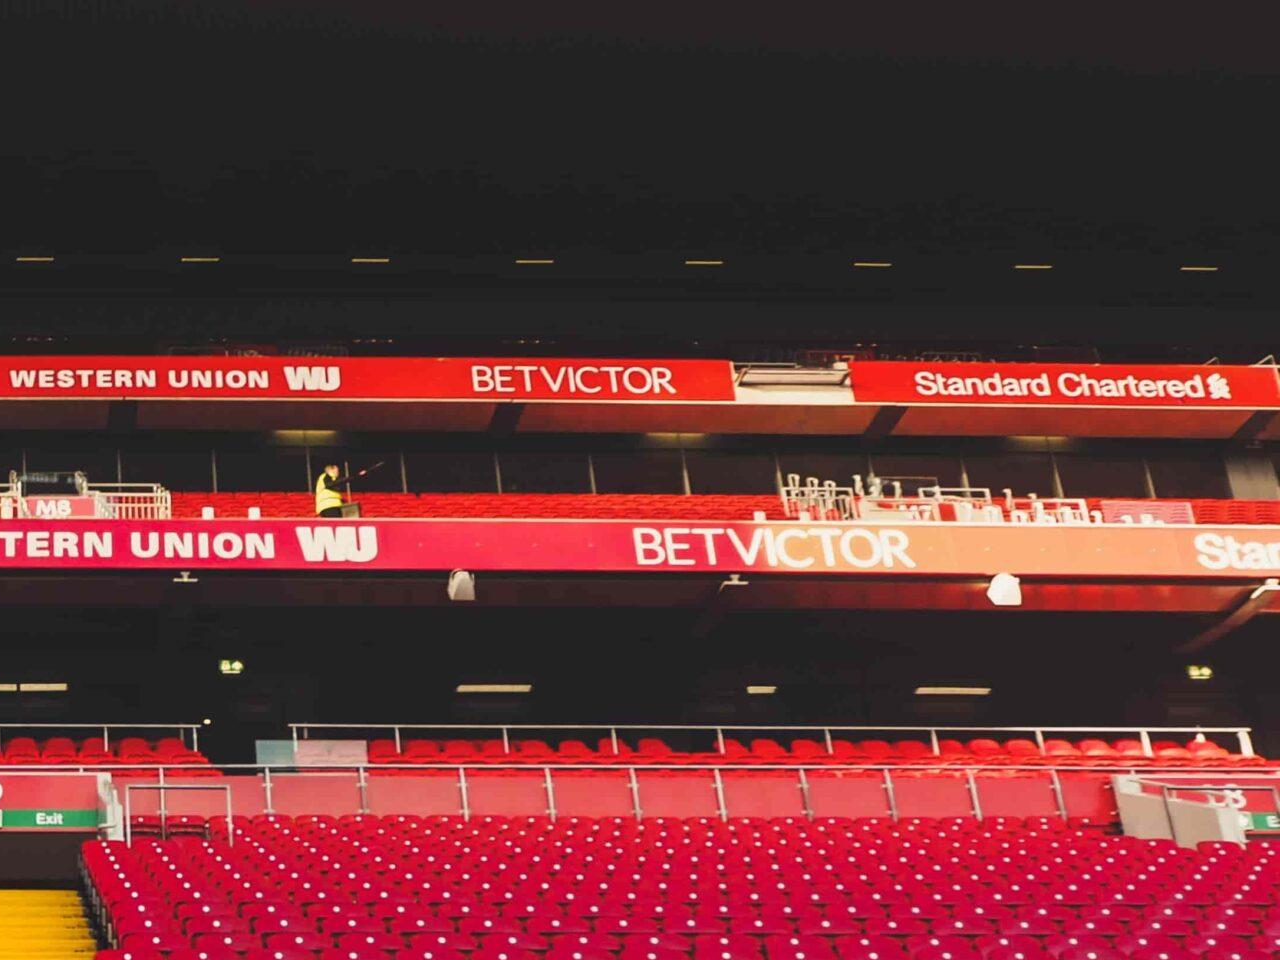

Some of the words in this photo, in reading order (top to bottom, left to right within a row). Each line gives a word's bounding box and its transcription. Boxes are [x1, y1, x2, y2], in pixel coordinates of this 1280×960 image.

[10, 369, 156, 388] WESTERN
[168, 370, 269, 389] UNION
[283, 366, 342, 391] WU
[470, 364, 677, 396] BETVICTOR
[914, 371, 1049, 397] Standard
[1058, 374, 1205, 399] Chartered
[130, 531, 275, 559] UNION
[295, 525, 379, 563] WU
[632, 527, 917, 570] BETVICTOR
[35, 812, 63, 825] Exit
